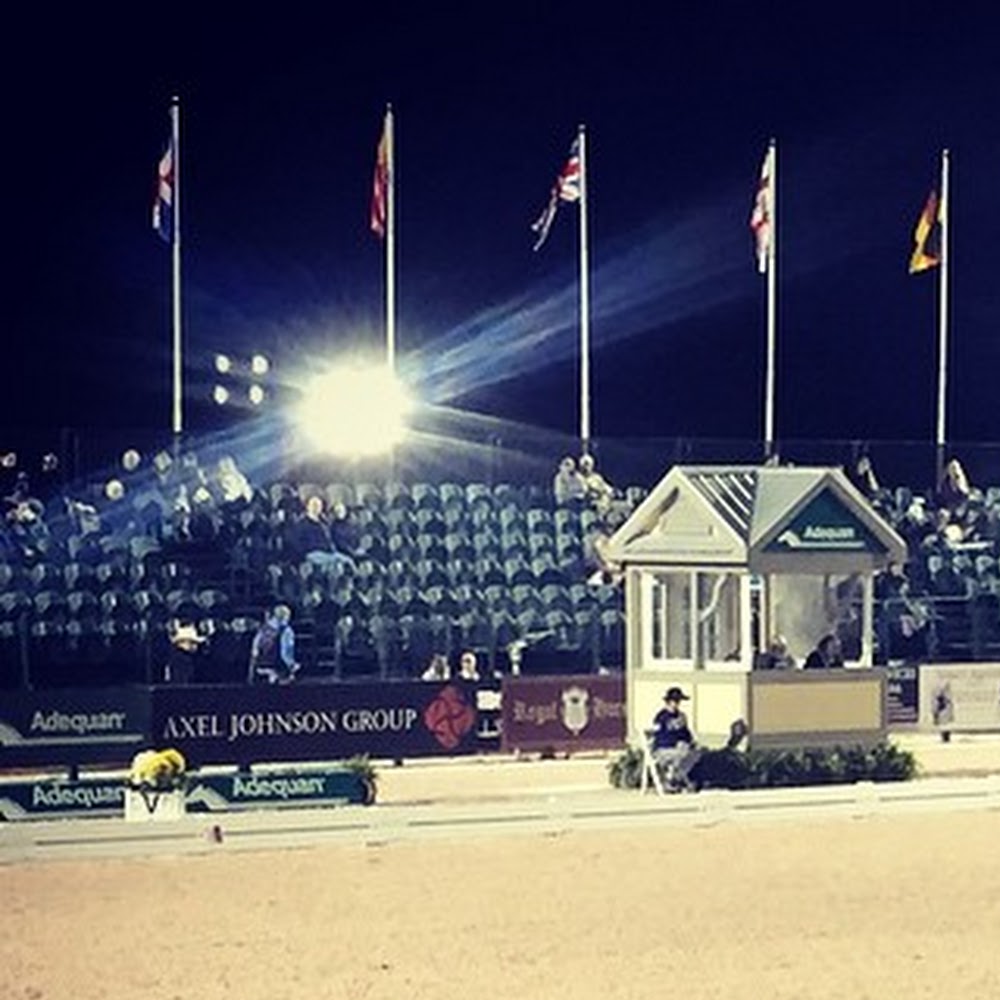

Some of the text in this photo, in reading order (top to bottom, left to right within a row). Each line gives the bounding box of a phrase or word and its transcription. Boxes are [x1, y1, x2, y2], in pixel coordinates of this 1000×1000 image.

[30, 710, 126, 733] Adequan
[164, 708, 417, 741] AXEL JOHNSON GROUP
[233, 777, 326, 798] Adequan
